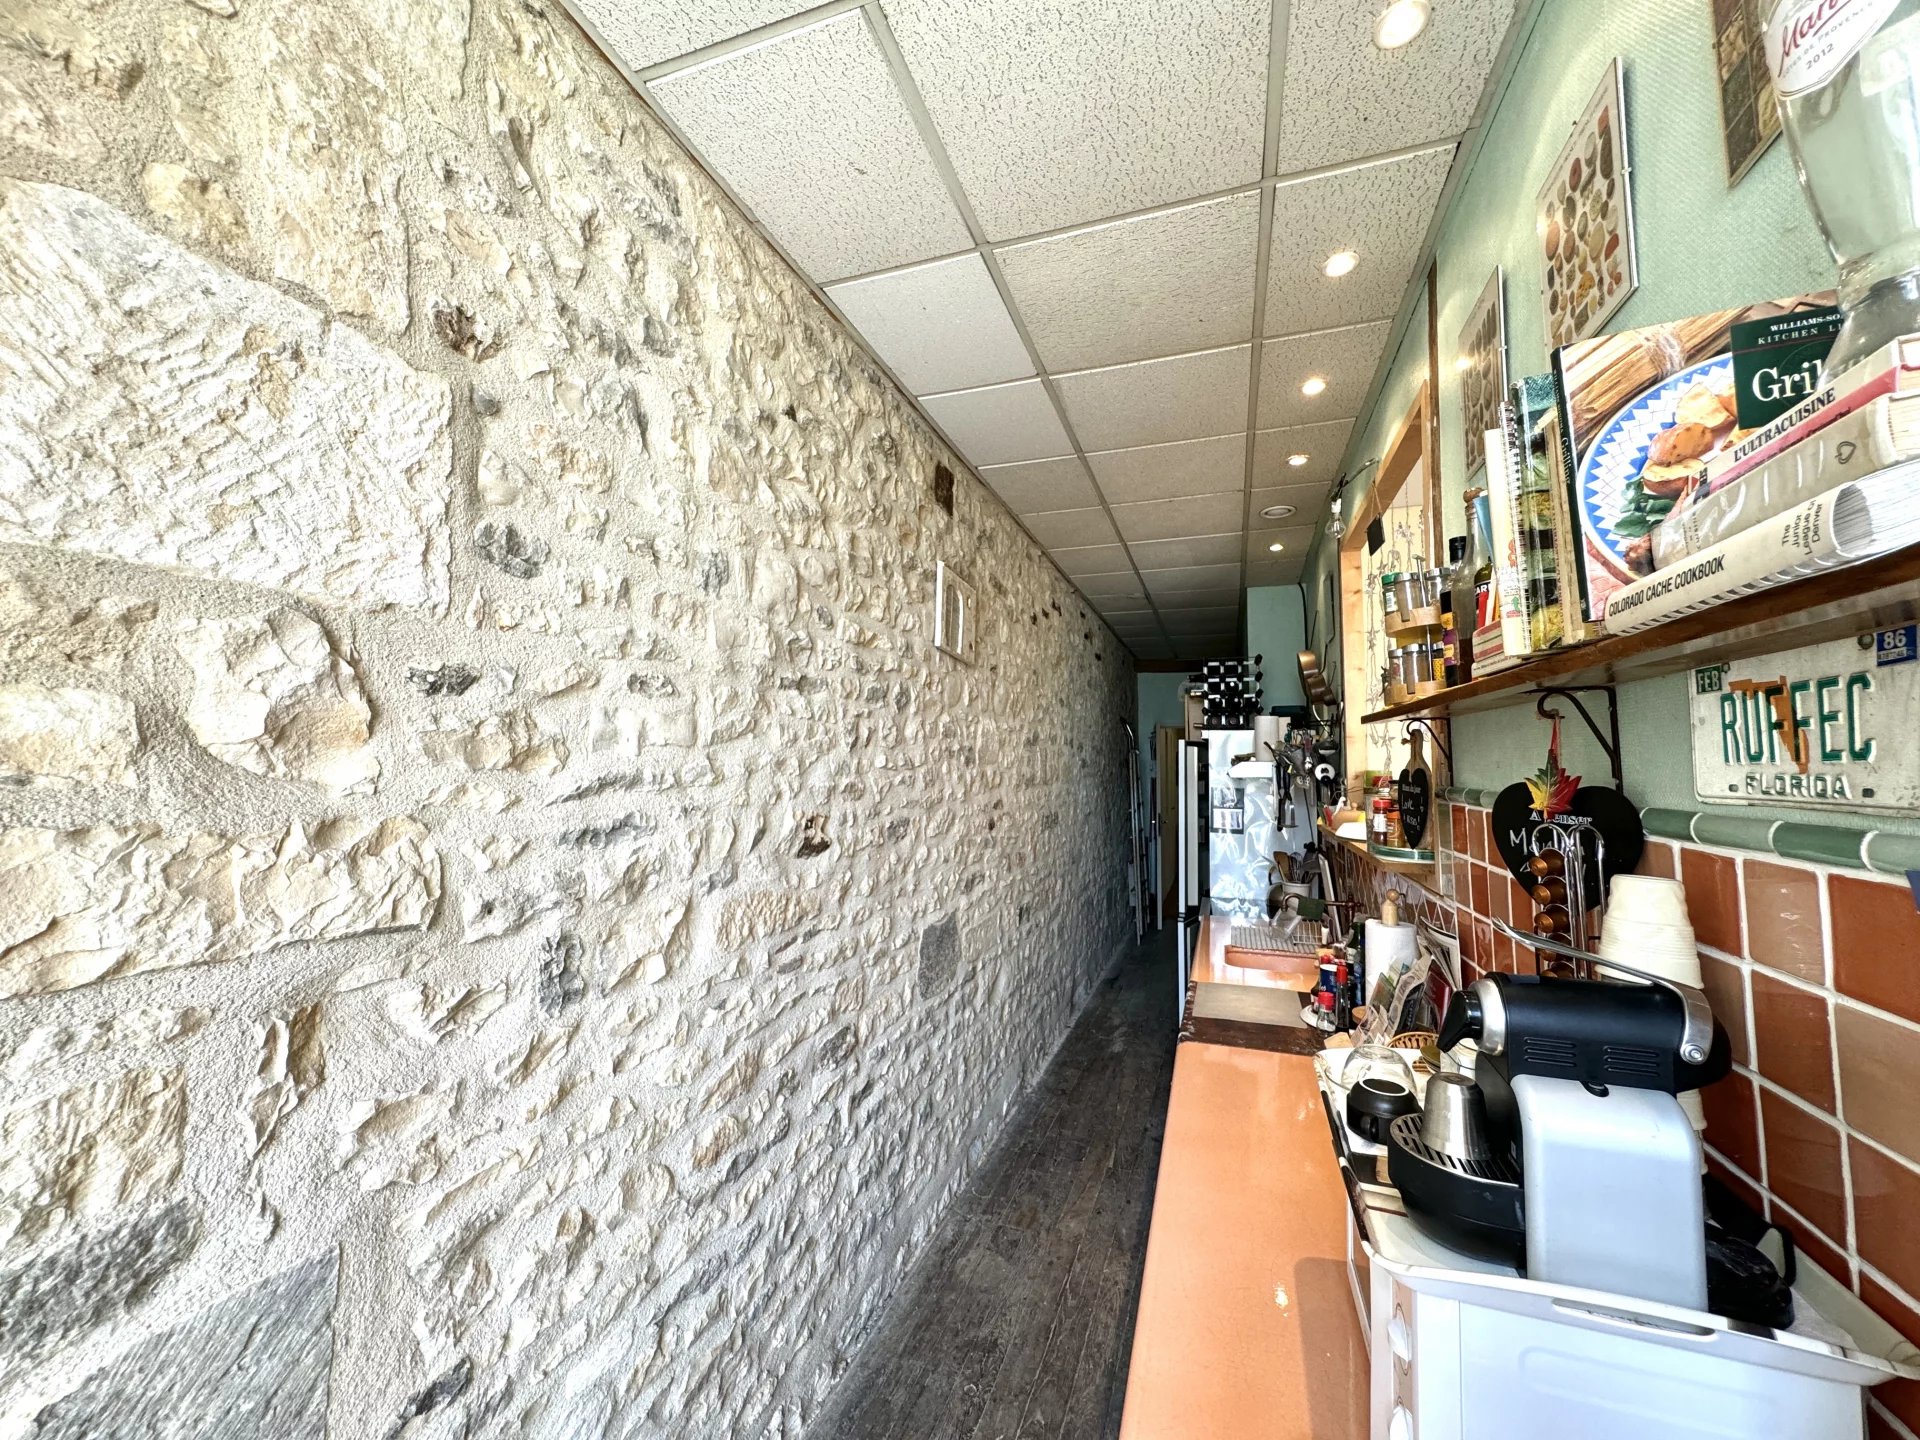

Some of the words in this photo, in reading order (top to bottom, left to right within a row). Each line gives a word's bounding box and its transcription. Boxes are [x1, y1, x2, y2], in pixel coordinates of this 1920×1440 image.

[1805, 43, 1834, 70] 2012
[1758, 327, 1818, 345] KITCHEN
[1770, 313, 1843, 332] WILLIAMS-SO
[1752, 358, 1821, 402] Gril
[1734, 387, 1836, 463] L'ULTRACUISINE
[1781, 524, 1791, 547] The
[1791, 514, 1802, 548] Junior
[1802, 513, 1813, 555] League
[1811, 503, 1823, 543] Denver
[1608, 589, 1644, 617] COLORADO
[1645, 577, 1673, 602] CACHE
[1674, 554, 1726, 590] COOKBOOK
[1883, 629, 1907, 650] 86
[1697, 673, 1721, 695] FEB
[1720, 671, 1877, 766] RUFFEC
[1746, 771, 1853, 800] FLORIDA
[1529, 809, 1542, 821] A
[1545, 813, 1593, 826] enser
